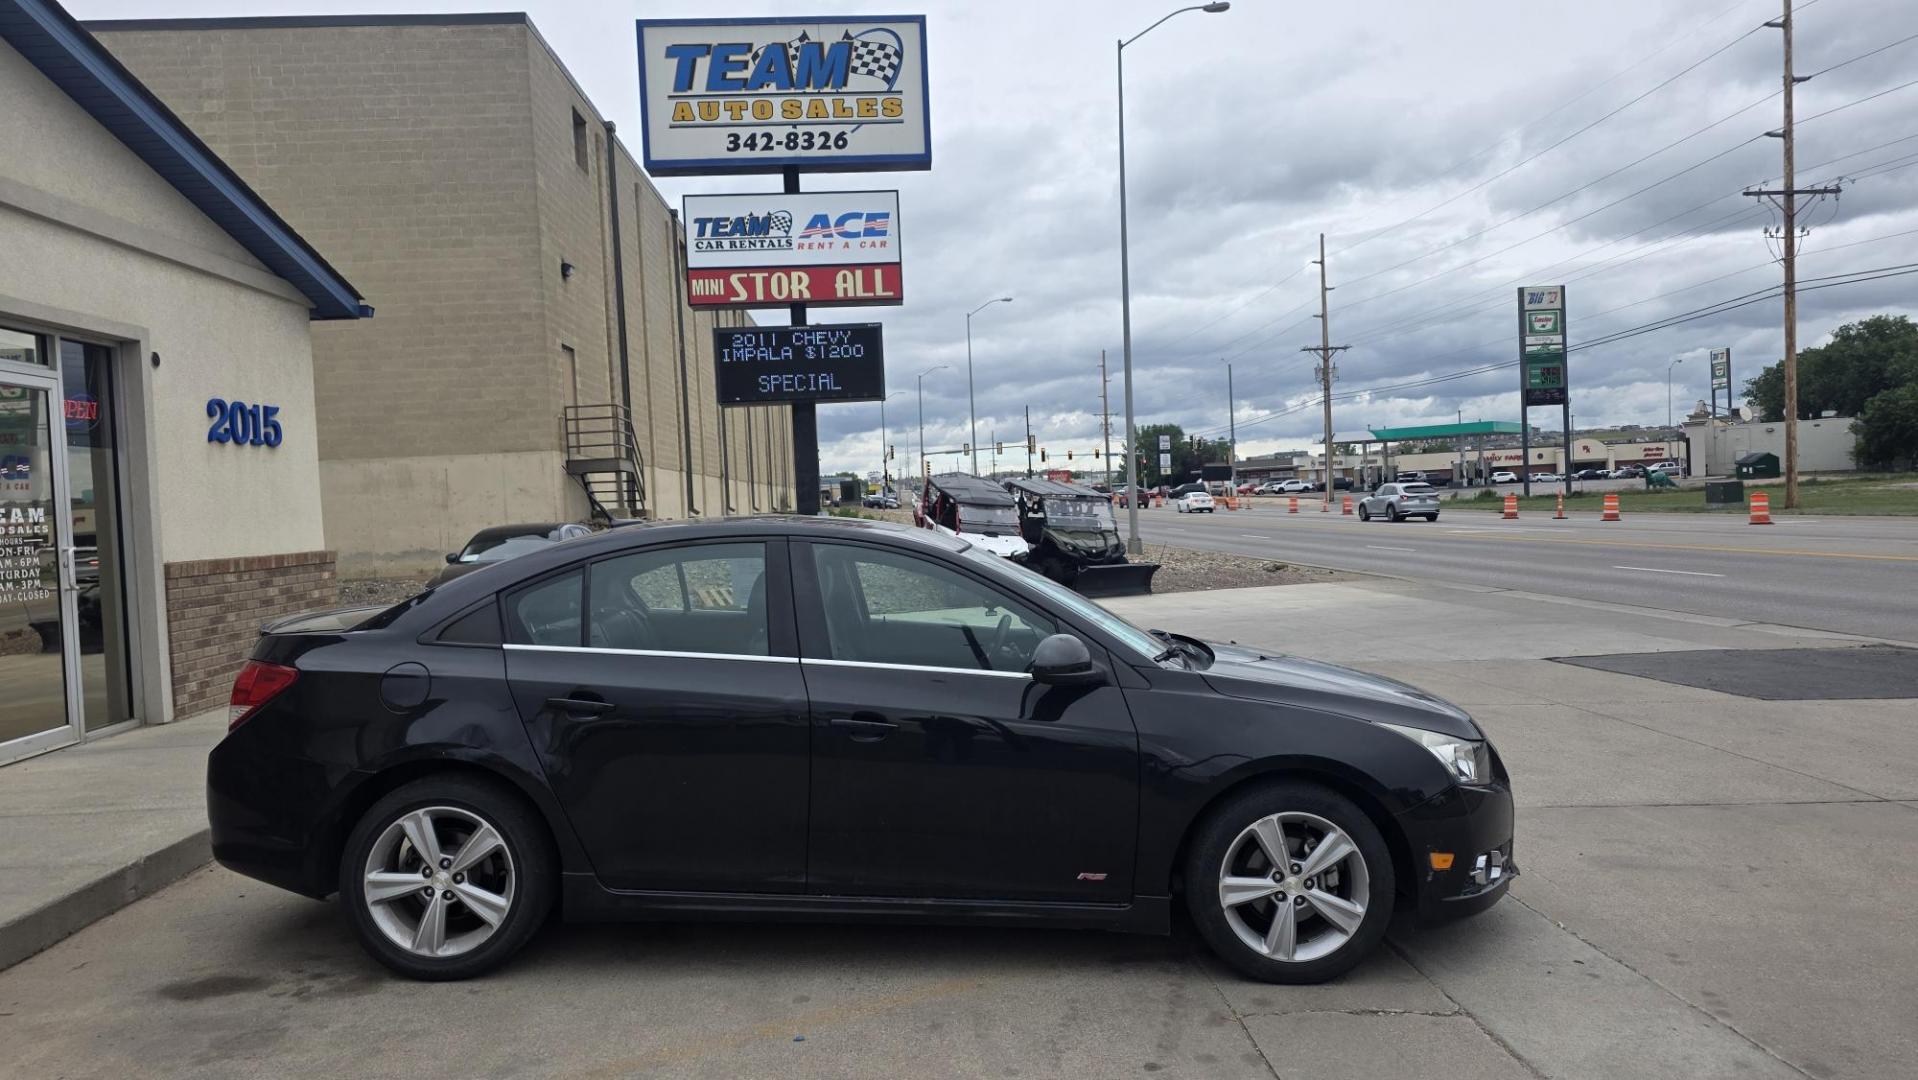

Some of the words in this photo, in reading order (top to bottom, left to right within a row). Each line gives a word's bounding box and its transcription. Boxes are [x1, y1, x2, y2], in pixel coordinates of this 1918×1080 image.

[665, 42, 854, 92] TEAM
[727, 131, 848, 151] 342-8326
[693, 216, 771, 237] TEAM
[799, 212, 890, 239] ACE
[695, 241, 724, 250] CAR
[729, 239, 793, 249] RENTALS
[797, 241, 835, 250] RENT
[859, 240, 889, 248] CAR
[692, 278, 725, 296] MINI
[729, 271, 811, 302] STOR
[835, 268, 894, 298] ALL
[732, 333, 775, 348] 2011
[792, 330, 851, 346] CHEVY
[722, 346, 793, 362] IMPALA
[805, 344, 864, 359] $1200
[758, 373, 842, 393] SPECIAL
[206, 398, 282, 448] 2015
